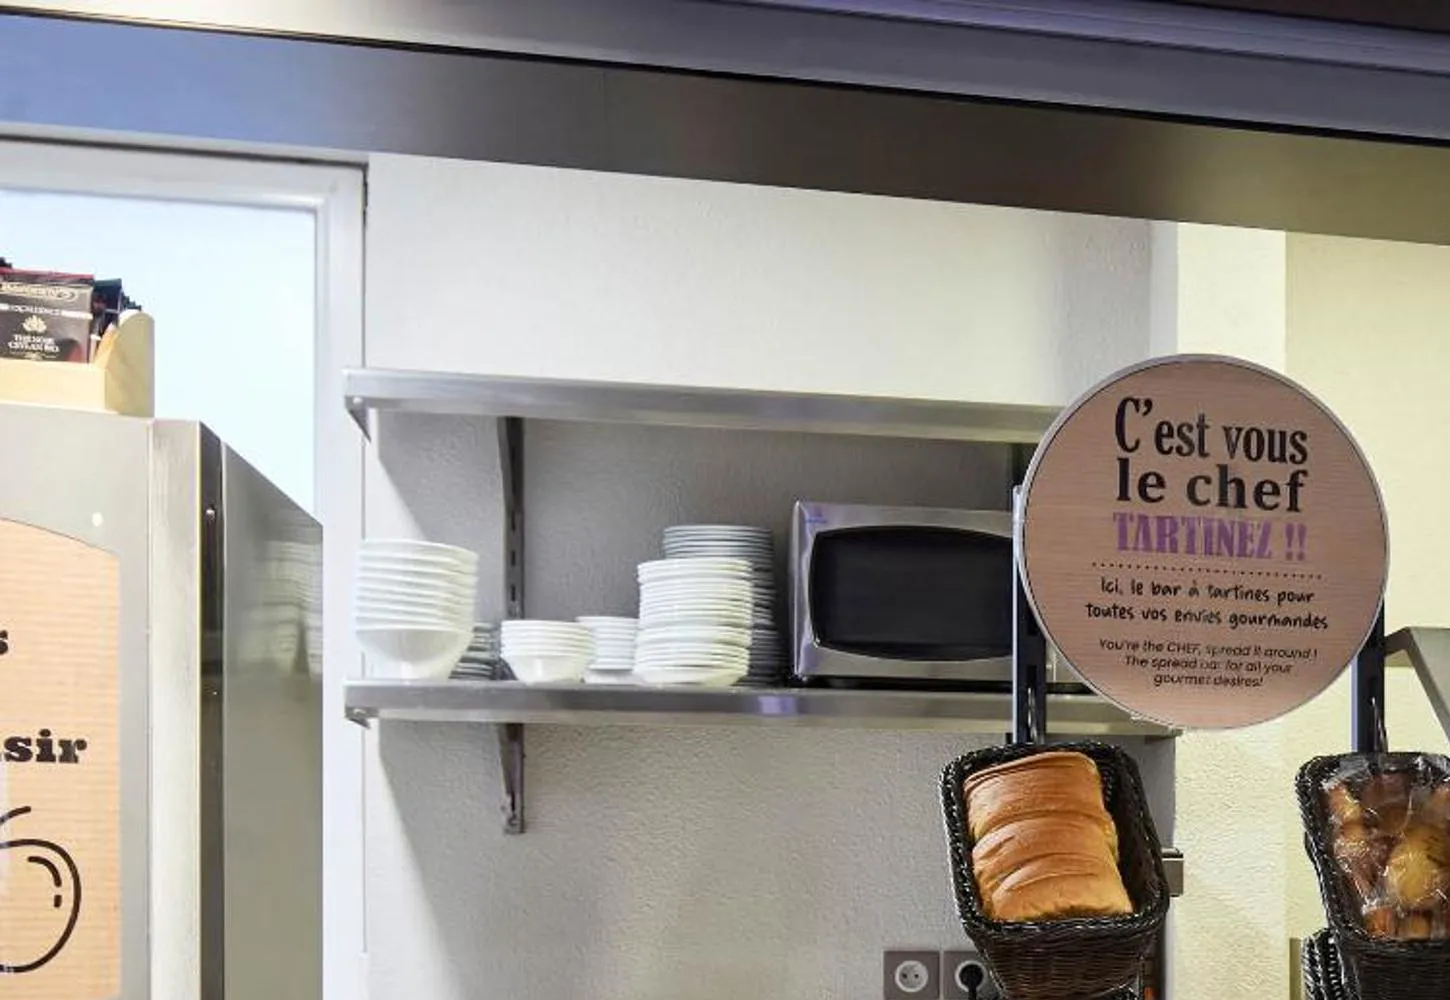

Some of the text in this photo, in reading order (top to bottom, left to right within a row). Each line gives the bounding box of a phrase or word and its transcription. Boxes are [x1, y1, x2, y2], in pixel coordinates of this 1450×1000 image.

[1222, 425, 1308, 465] vous
[1117, 458, 1309, 513] le chef
[1113, 512, 1307, 561] TARTINEZ !!
[1131, 580, 1143, 596] le
[1151, 581, 1181, 597] bar
[1188, 580, 1199, 597] à
[1207, 584, 1269, 602] tartines
[1277, 591, 1314, 605] pour
[1086, 603, 1328, 629] toutes vos envies gourmandes
[1143, 640, 1164, 653] the
[1206, 644, 1252, 657] spread
[1126, 655, 1149, 667] The
[1152, 658, 1198, 672] spread
[1225, 660, 1243, 671] for
[1245, 661, 1262, 672] all
[1263, 663, 1293, 675] your
[1153, 673, 1212, 687] gourmet
[0, 728, 87, 764] sir
